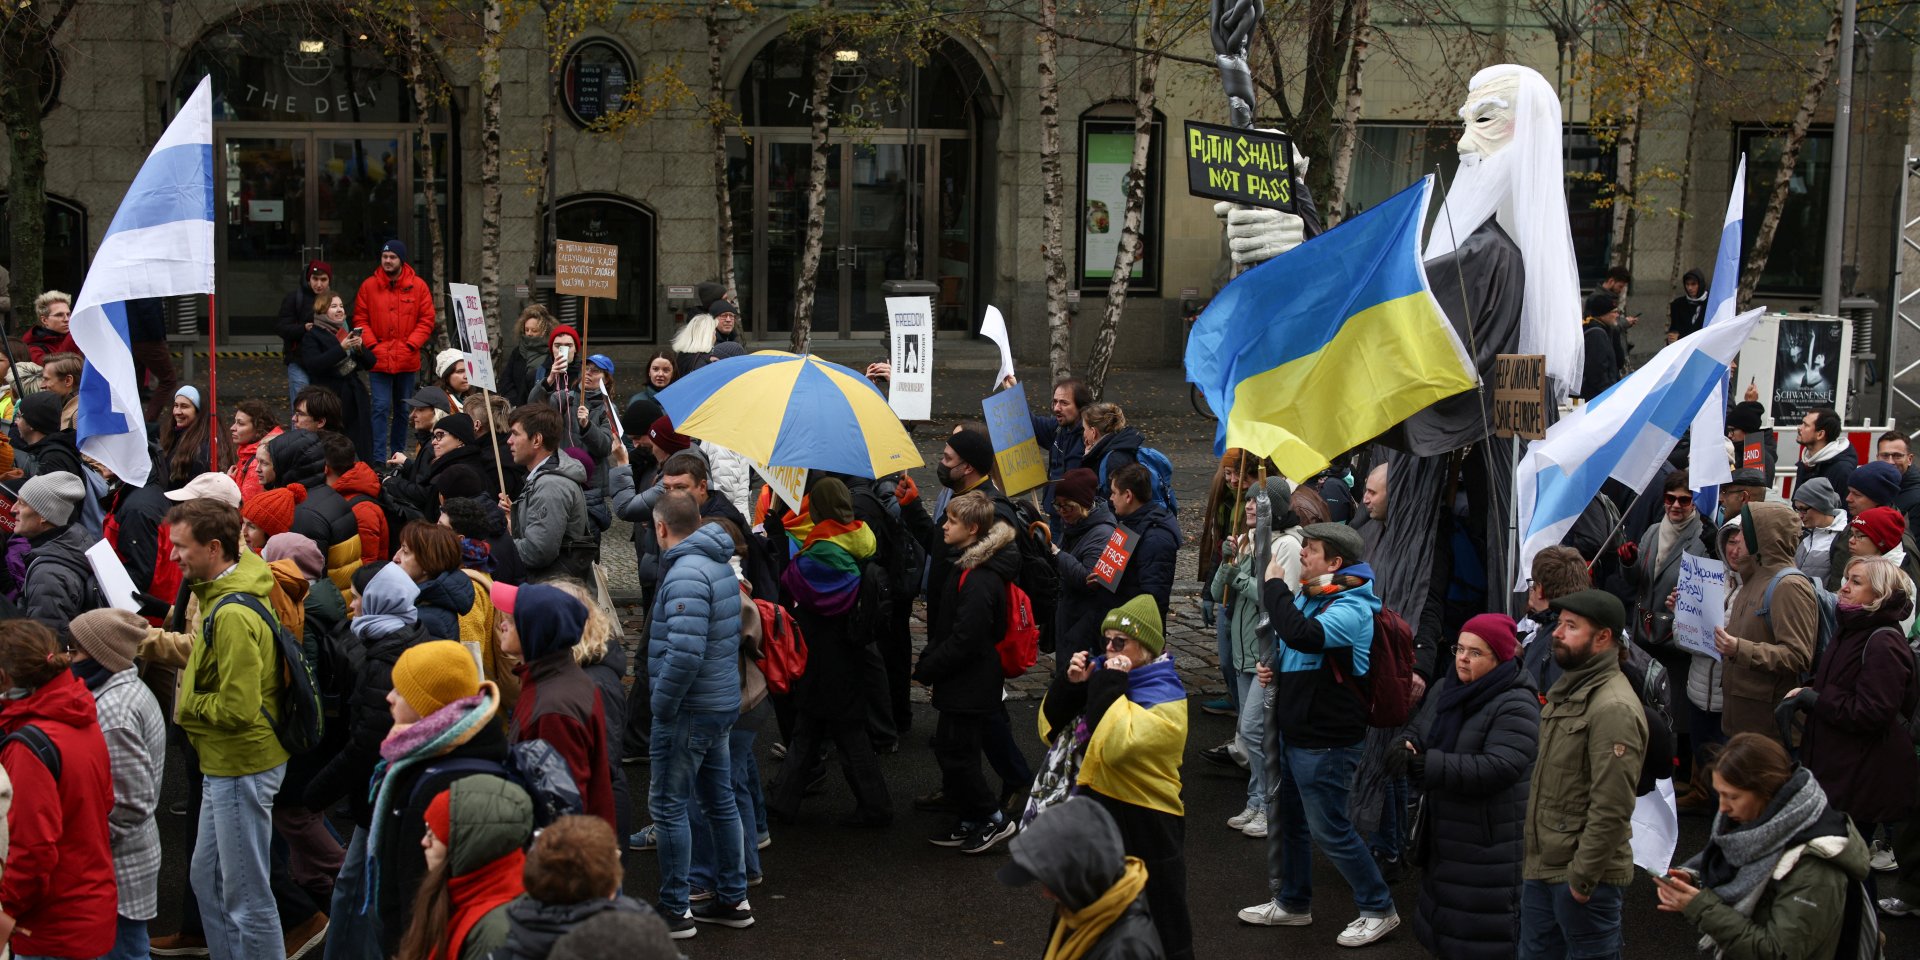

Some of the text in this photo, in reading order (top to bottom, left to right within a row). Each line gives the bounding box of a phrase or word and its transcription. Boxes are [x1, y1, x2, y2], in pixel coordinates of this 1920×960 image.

[246, 84, 377, 114] THE DELI
[851, 96, 908, 120] DELI
[1189, 128, 1288, 172] PUTIN SHALL
[1208, 167, 1290, 204] NOT PASS
[895, 313, 925, 326] FREEDOM
[1510, 358, 1542, 391] UKRAINE
[1774, 388, 1835, 403] SCHWANENSEE
[1496, 399, 1541, 434] SAVE EUROPE
[1000, 440, 1041, 478] UKRAINE
[1106, 548, 1126, 567] FACE
